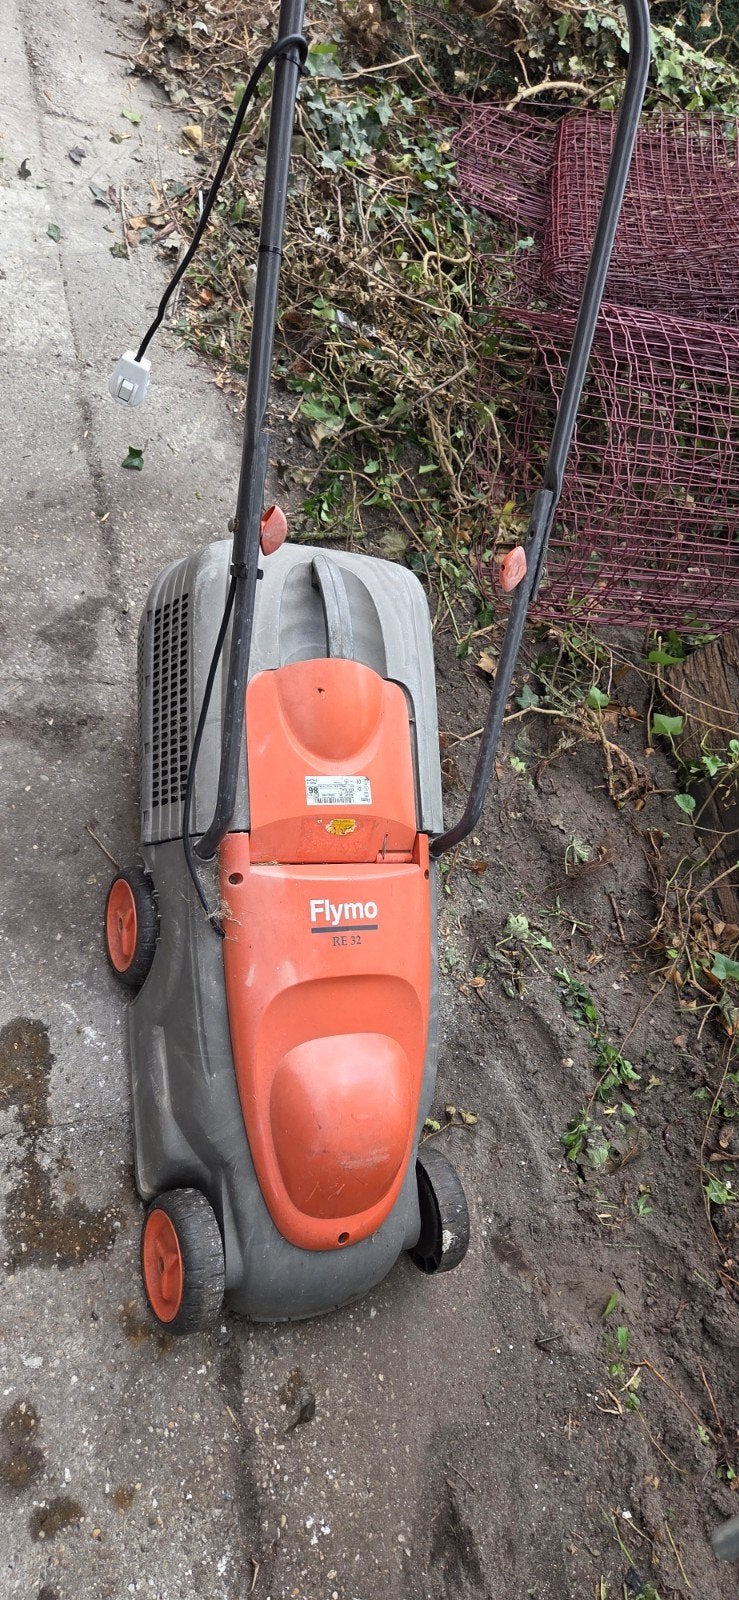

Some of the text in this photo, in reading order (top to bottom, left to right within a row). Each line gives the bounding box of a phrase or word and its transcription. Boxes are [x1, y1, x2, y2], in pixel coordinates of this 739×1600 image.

[310, 899, 378, 925] Flymo
[333, 935, 361, 946] RE 32
